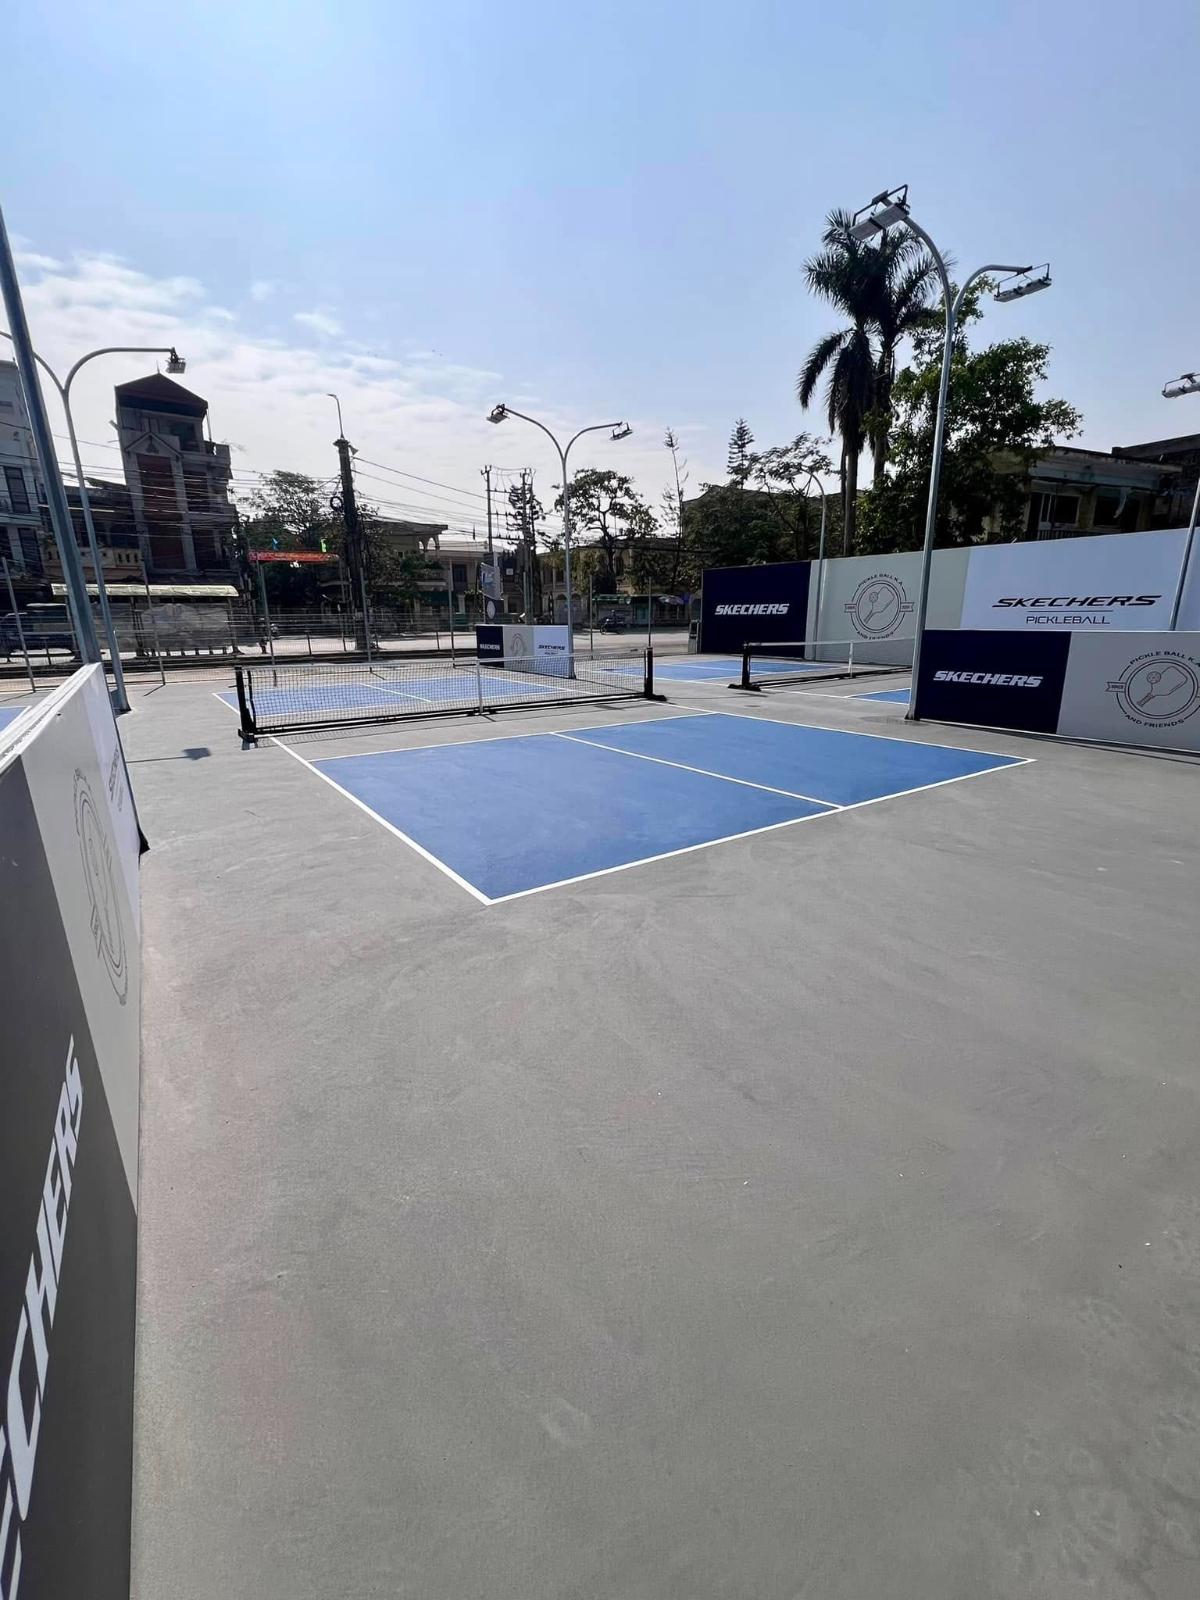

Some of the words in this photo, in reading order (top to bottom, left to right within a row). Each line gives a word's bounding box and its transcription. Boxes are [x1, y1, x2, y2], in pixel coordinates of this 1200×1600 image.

[992, 595, 1162, 608] SKECHERS
[715, 603, 790, 615] SKECHERS
[1026, 616, 1111, 624] PICKLEBALL
[1130, 650, 1161, 665] PICKLE
[1164, 650, 1186, 659] BALL
[933, 670, 1044, 687] SKECHERS
[1125, 714, 1142, 725] AND
[1144, 719, 1185, 728] FRIENDS
